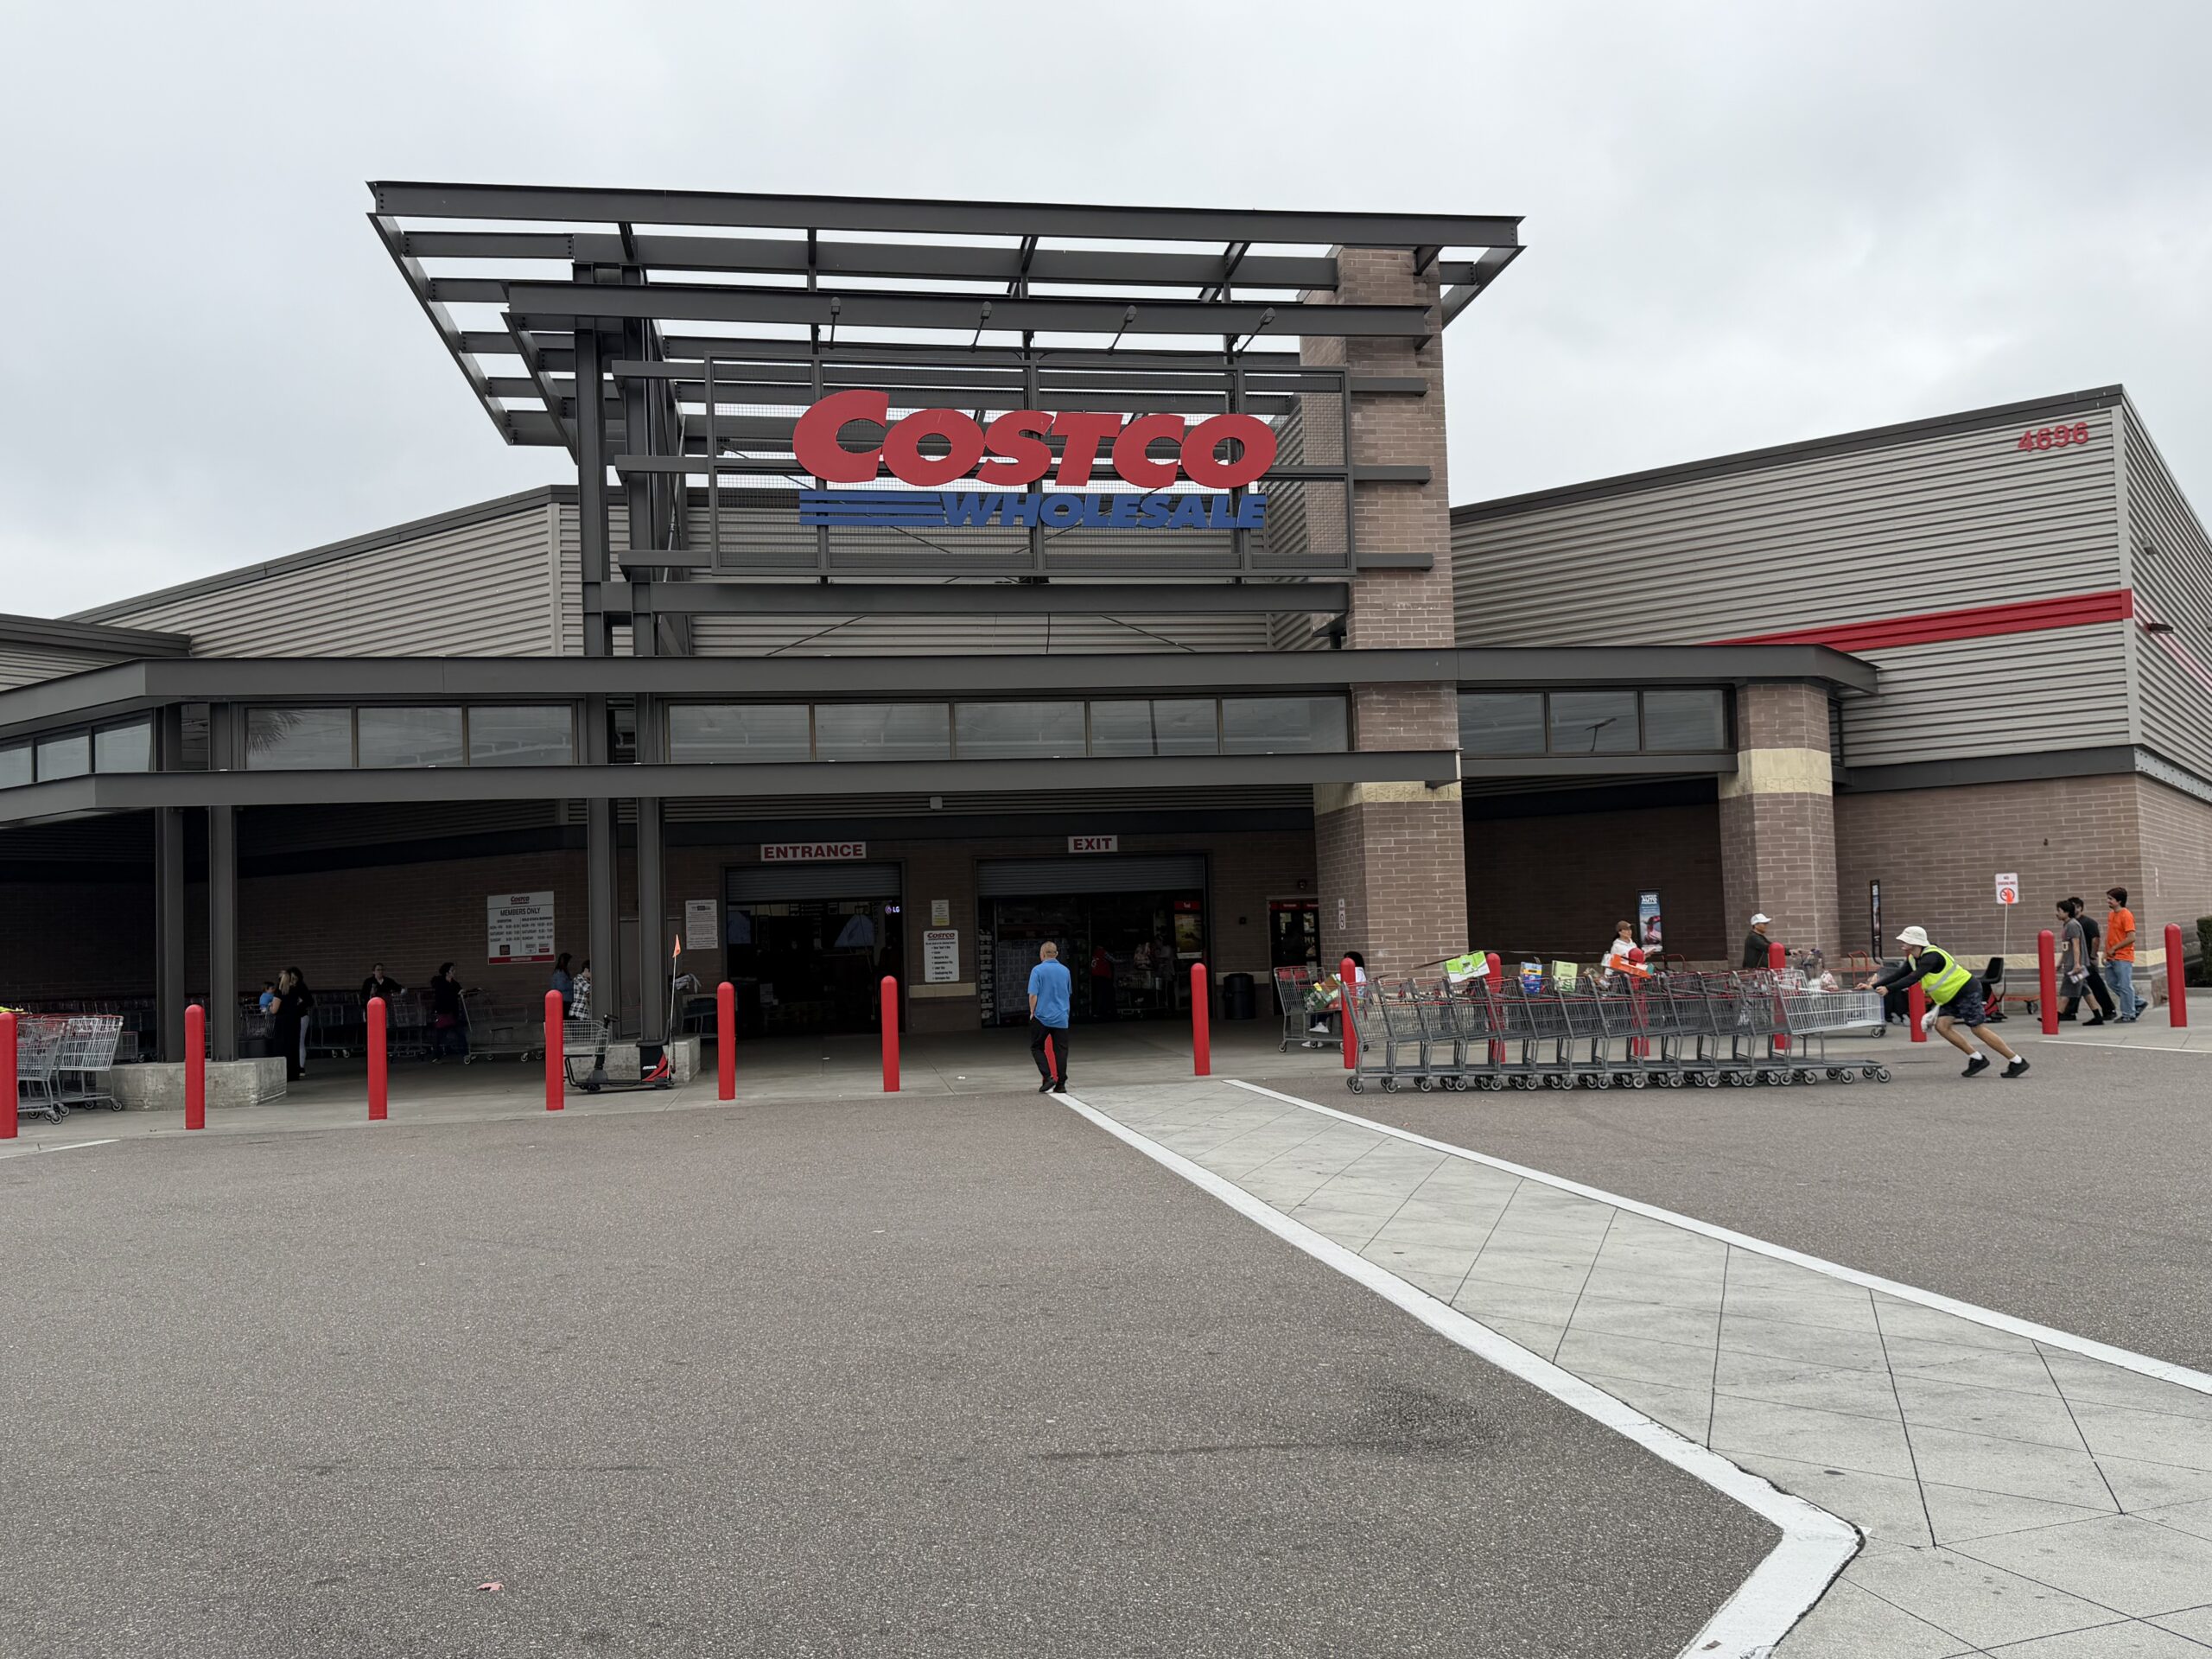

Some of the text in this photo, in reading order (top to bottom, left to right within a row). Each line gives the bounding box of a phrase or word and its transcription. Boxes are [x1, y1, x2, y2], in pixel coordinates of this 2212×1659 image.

[792, 389, 1277, 489] COSTCO
[2018, 421, 2088, 452] 4696
[940, 493, 1268, 529] WHOLESALE
[764, 844, 863, 859] ENTRANCE
[1073, 837, 1112, 850] EXIT
